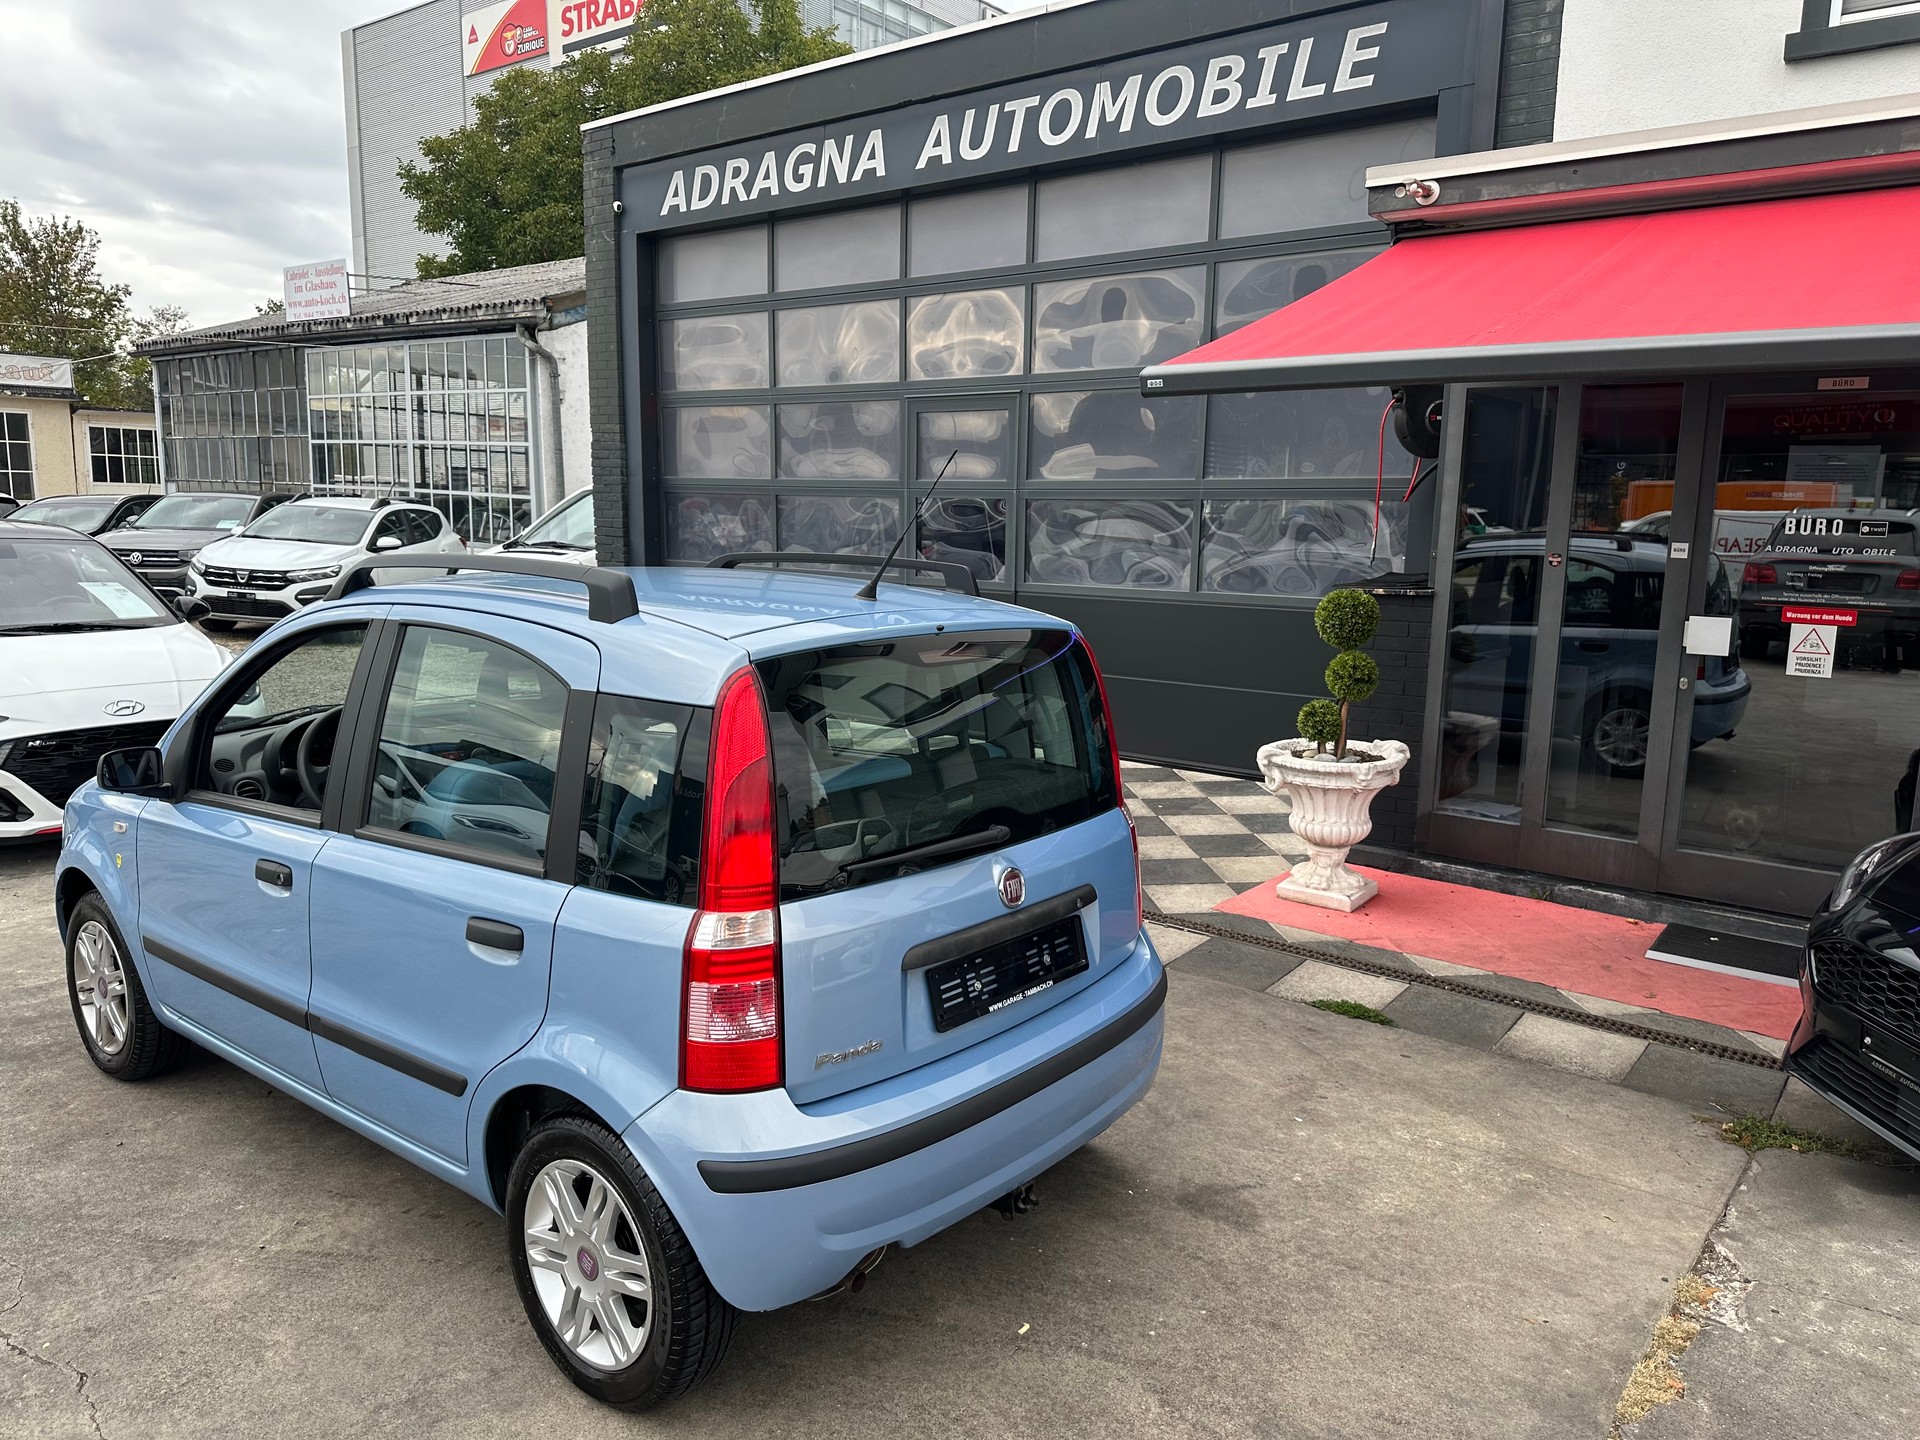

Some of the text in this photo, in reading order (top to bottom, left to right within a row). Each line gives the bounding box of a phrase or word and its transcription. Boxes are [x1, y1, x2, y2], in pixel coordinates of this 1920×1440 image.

[517, 37, 545, 54] ZURIQUE
[660, 22, 1388, 216] ADRAGNA AUTOMOBILE
[285, 268, 309, 282] Cabriolet
[314, 263, 345, 278] Ausstellung
[294, 279, 337, 293] im Glashaus
[288, 292, 347, 309] www.auto-koch.ch
[1832, 379, 1855, 387] BÜRO
[1774, 410, 1871, 427] QUALITY
[1784, 516, 1844, 536] BÜRO
[1832, 547, 1854, 555] UTO
[1862, 548, 1897, 557] OBILE
[1786, 611, 1811, 620] Warnung
[1835, 614, 1853, 622] Hunde
[1005, 877, 1021, 899] FIAT
[988, 980, 1054, 1013] WWW.GARAGE-TAMBACH.CH
[814, 1039, 883, 1070] Panda
